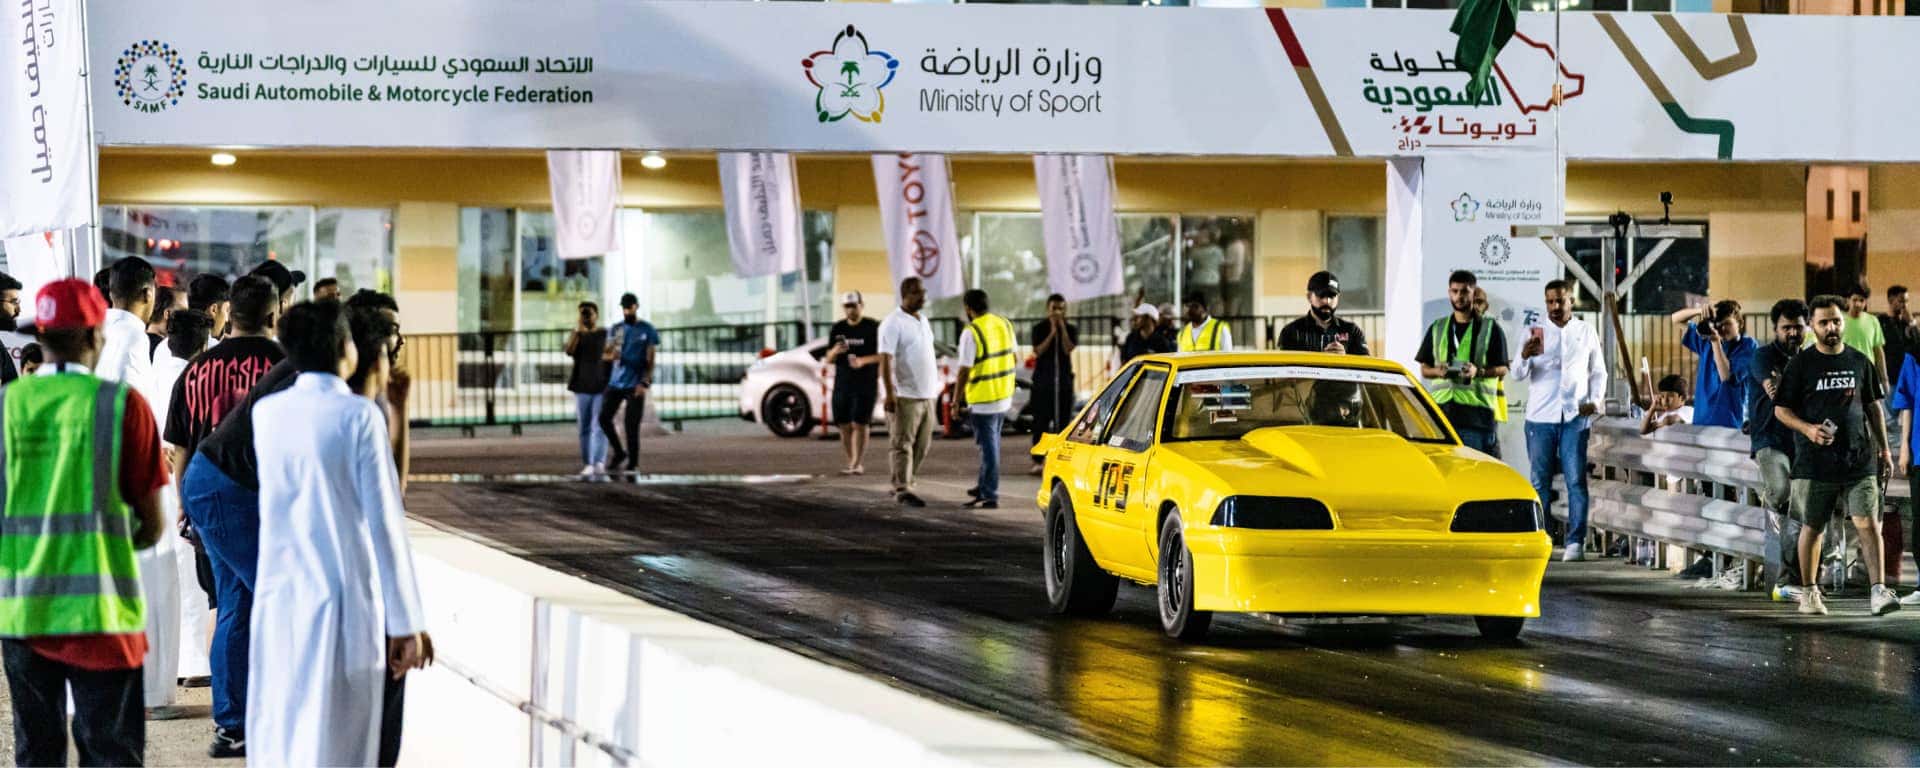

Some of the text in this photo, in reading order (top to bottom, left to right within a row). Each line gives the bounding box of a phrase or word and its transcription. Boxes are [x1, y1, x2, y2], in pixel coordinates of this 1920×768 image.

[198, 51, 593, 79] الاتحاد السعودي للسيارات والدراجات النارية
[920, 48, 1102, 84] وزارة الرياضة
[1370, 50, 1457, 76] طولة
[21, 0, 52, 183] للطيف جميل
[198, 83, 593, 106] Saudi Automobile & Motorcycle Federation
[920, 88, 1102, 118] Ministry of Sport
[134, 101, 168, 113] SAMF
[1438, 115, 1537, 140] تويوتا
[1816, 376, 1856, 391] ALESSA
